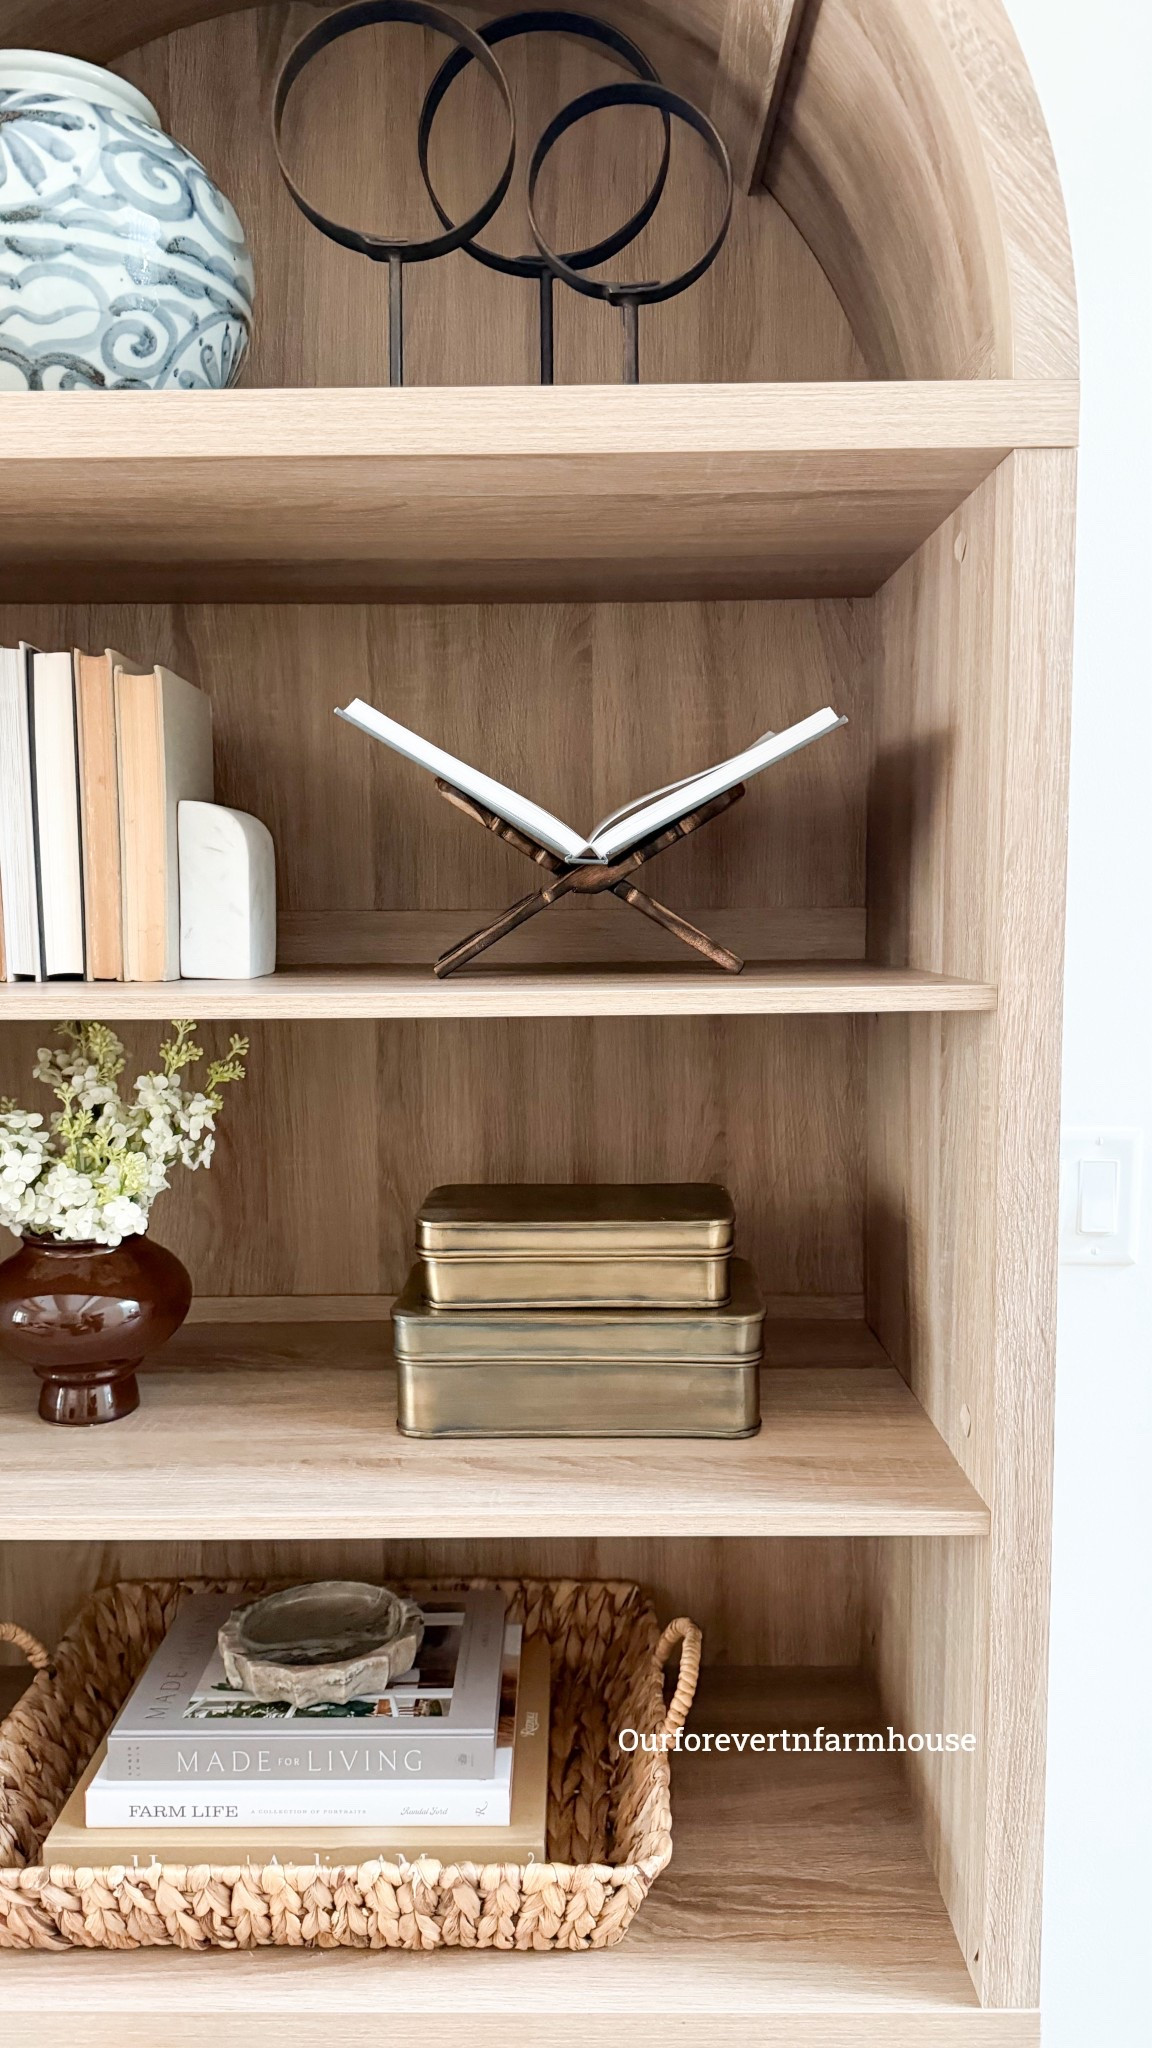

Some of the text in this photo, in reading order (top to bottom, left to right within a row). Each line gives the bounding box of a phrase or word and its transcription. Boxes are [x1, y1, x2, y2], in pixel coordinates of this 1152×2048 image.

[176, 1749, 423, 1773] MADE FOR LIVING
[128, 1805, 187, 1818] FARM
[191, 1805, 239, 1818] LIFE
